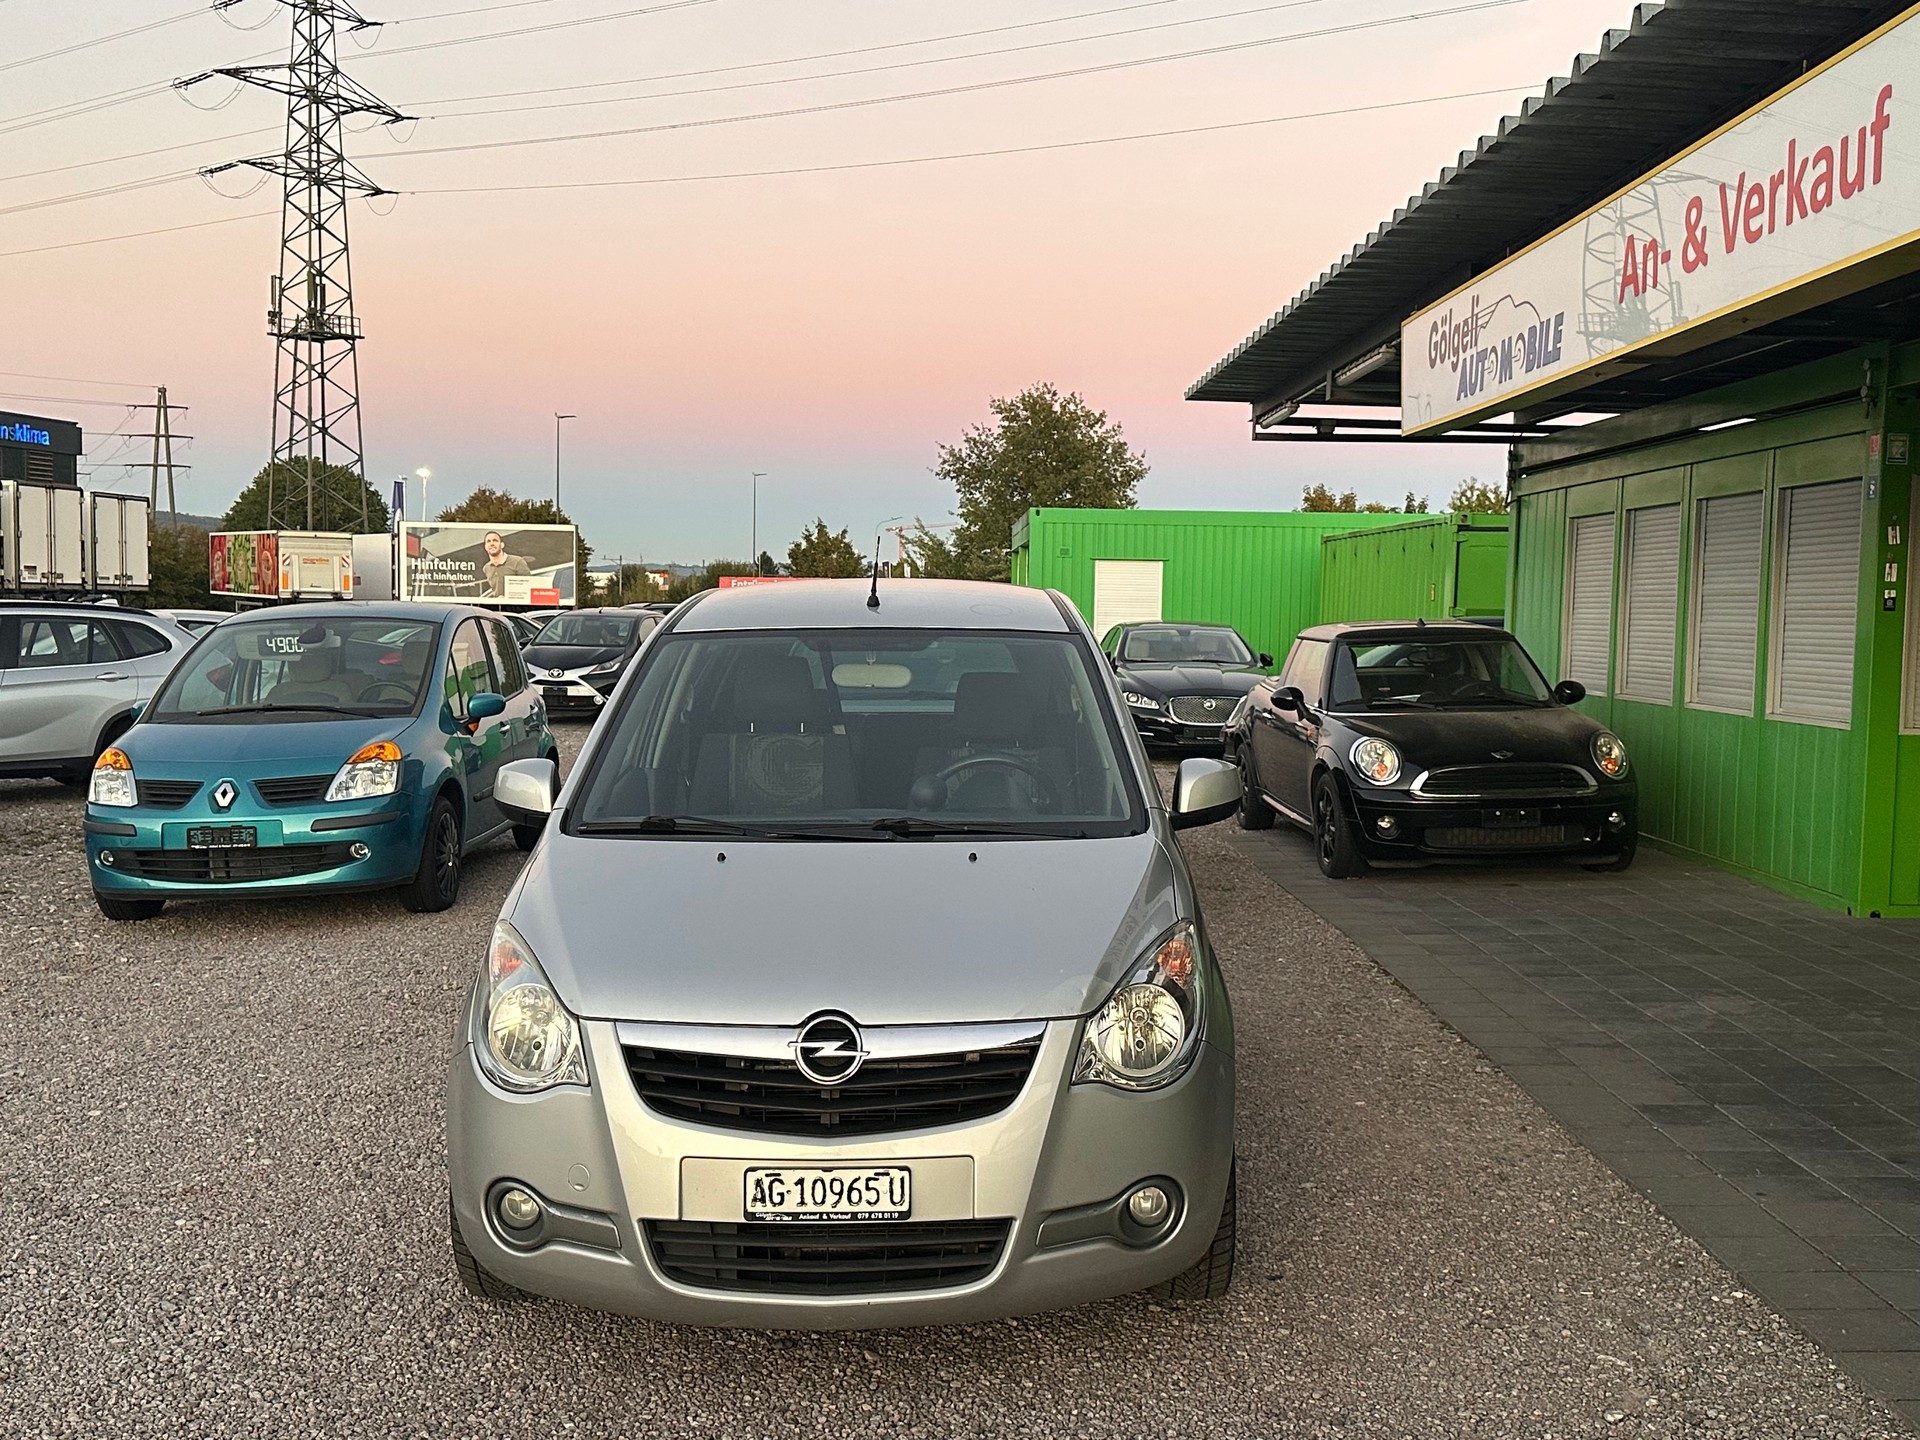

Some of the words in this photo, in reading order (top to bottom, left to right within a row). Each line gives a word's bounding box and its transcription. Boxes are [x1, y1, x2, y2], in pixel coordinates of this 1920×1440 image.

[1619, 234, 1671, 304] An-
[1681, 195, 1708, 274] &
[1718, 84, 1892, 254] Verkauf
[1428, 294, 1480, 373] Gölgeli
[1456, 311, 1565, 401] AUTOMOBILE
[411, 557, 476, 571] Hinfahren
[411, 572, 432, 580] statt
[433, 572, 476, 581] hinhalten.
[829, 1213, 851, 1221] Verkauf
